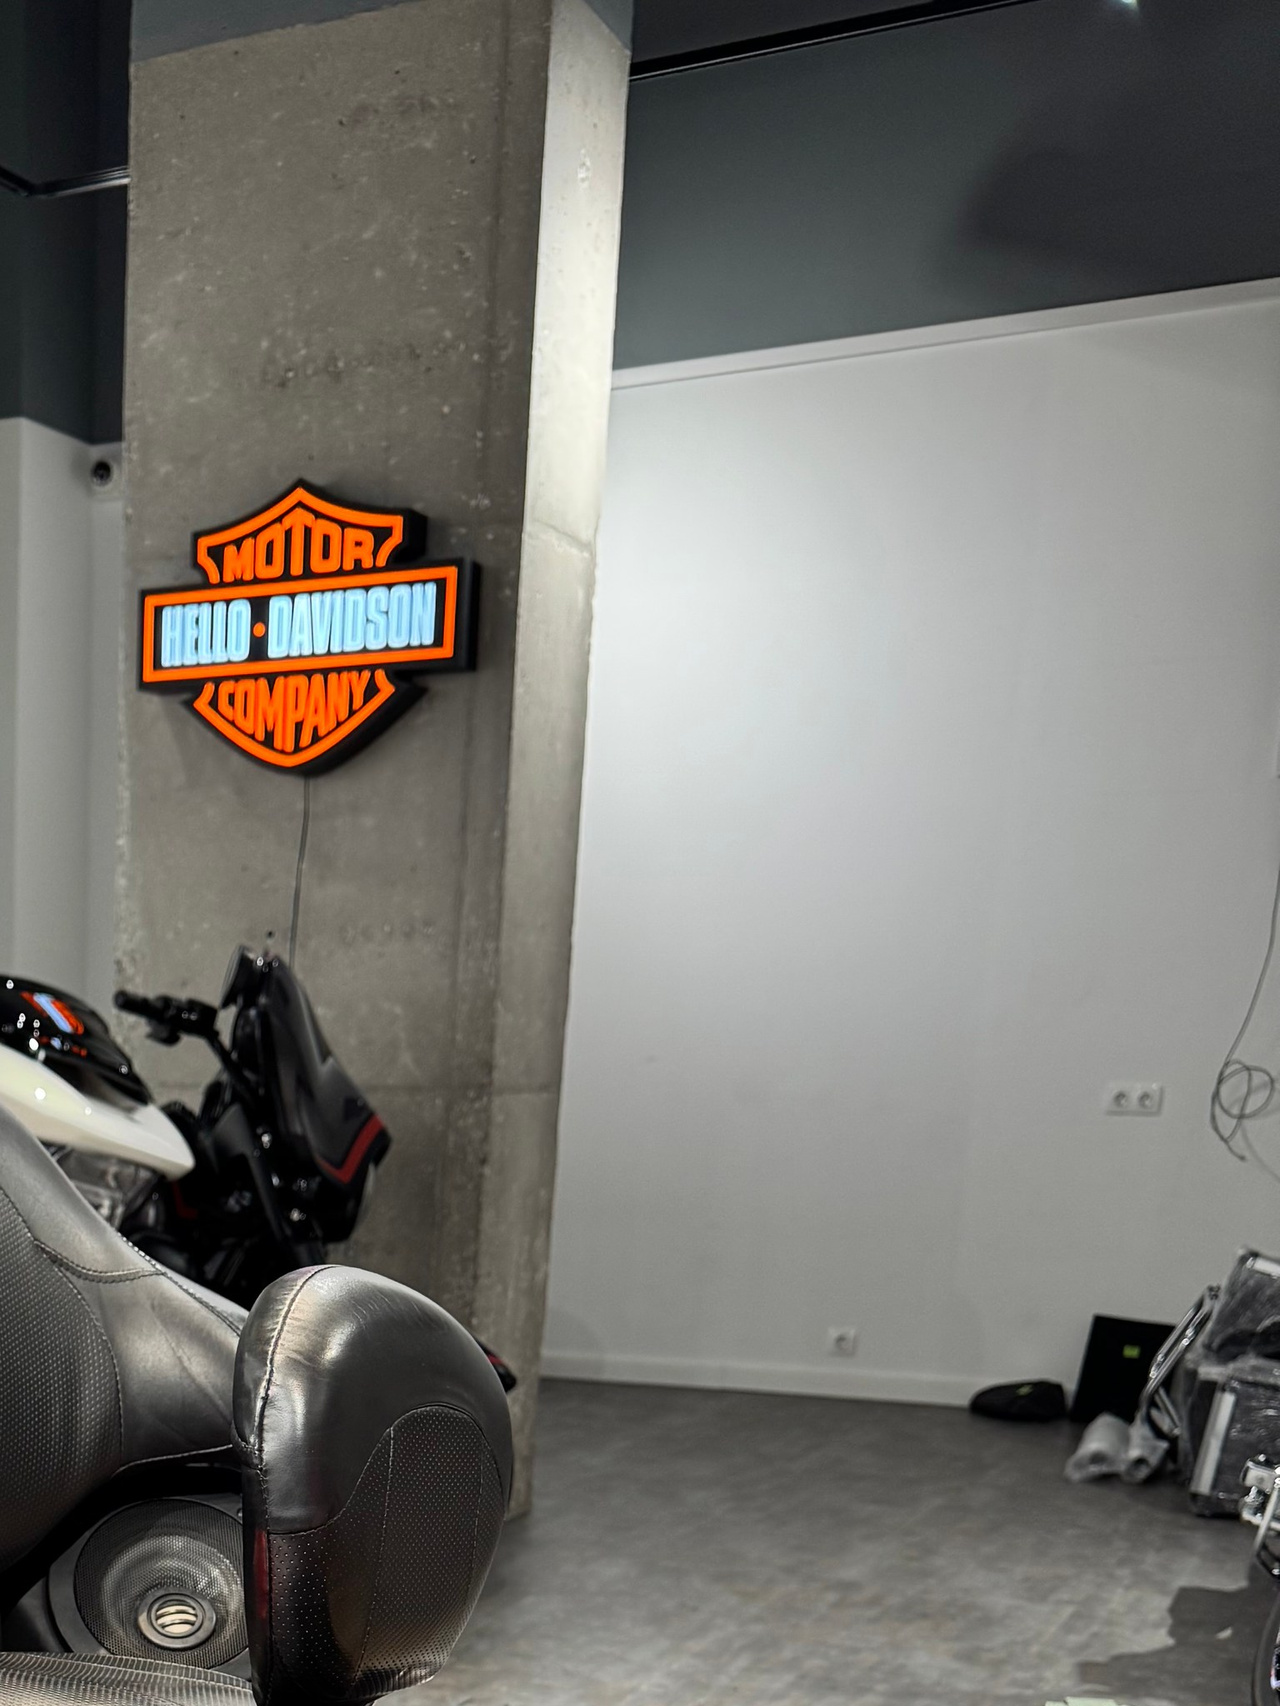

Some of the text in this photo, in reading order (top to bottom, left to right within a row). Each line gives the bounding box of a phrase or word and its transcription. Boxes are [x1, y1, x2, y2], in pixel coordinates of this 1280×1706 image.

[223, 508, 374, 583] MOTOR
[161, 582, 437, 667] HELLO DAVIDSON
[218, 670, 371, 752] COMPANY
